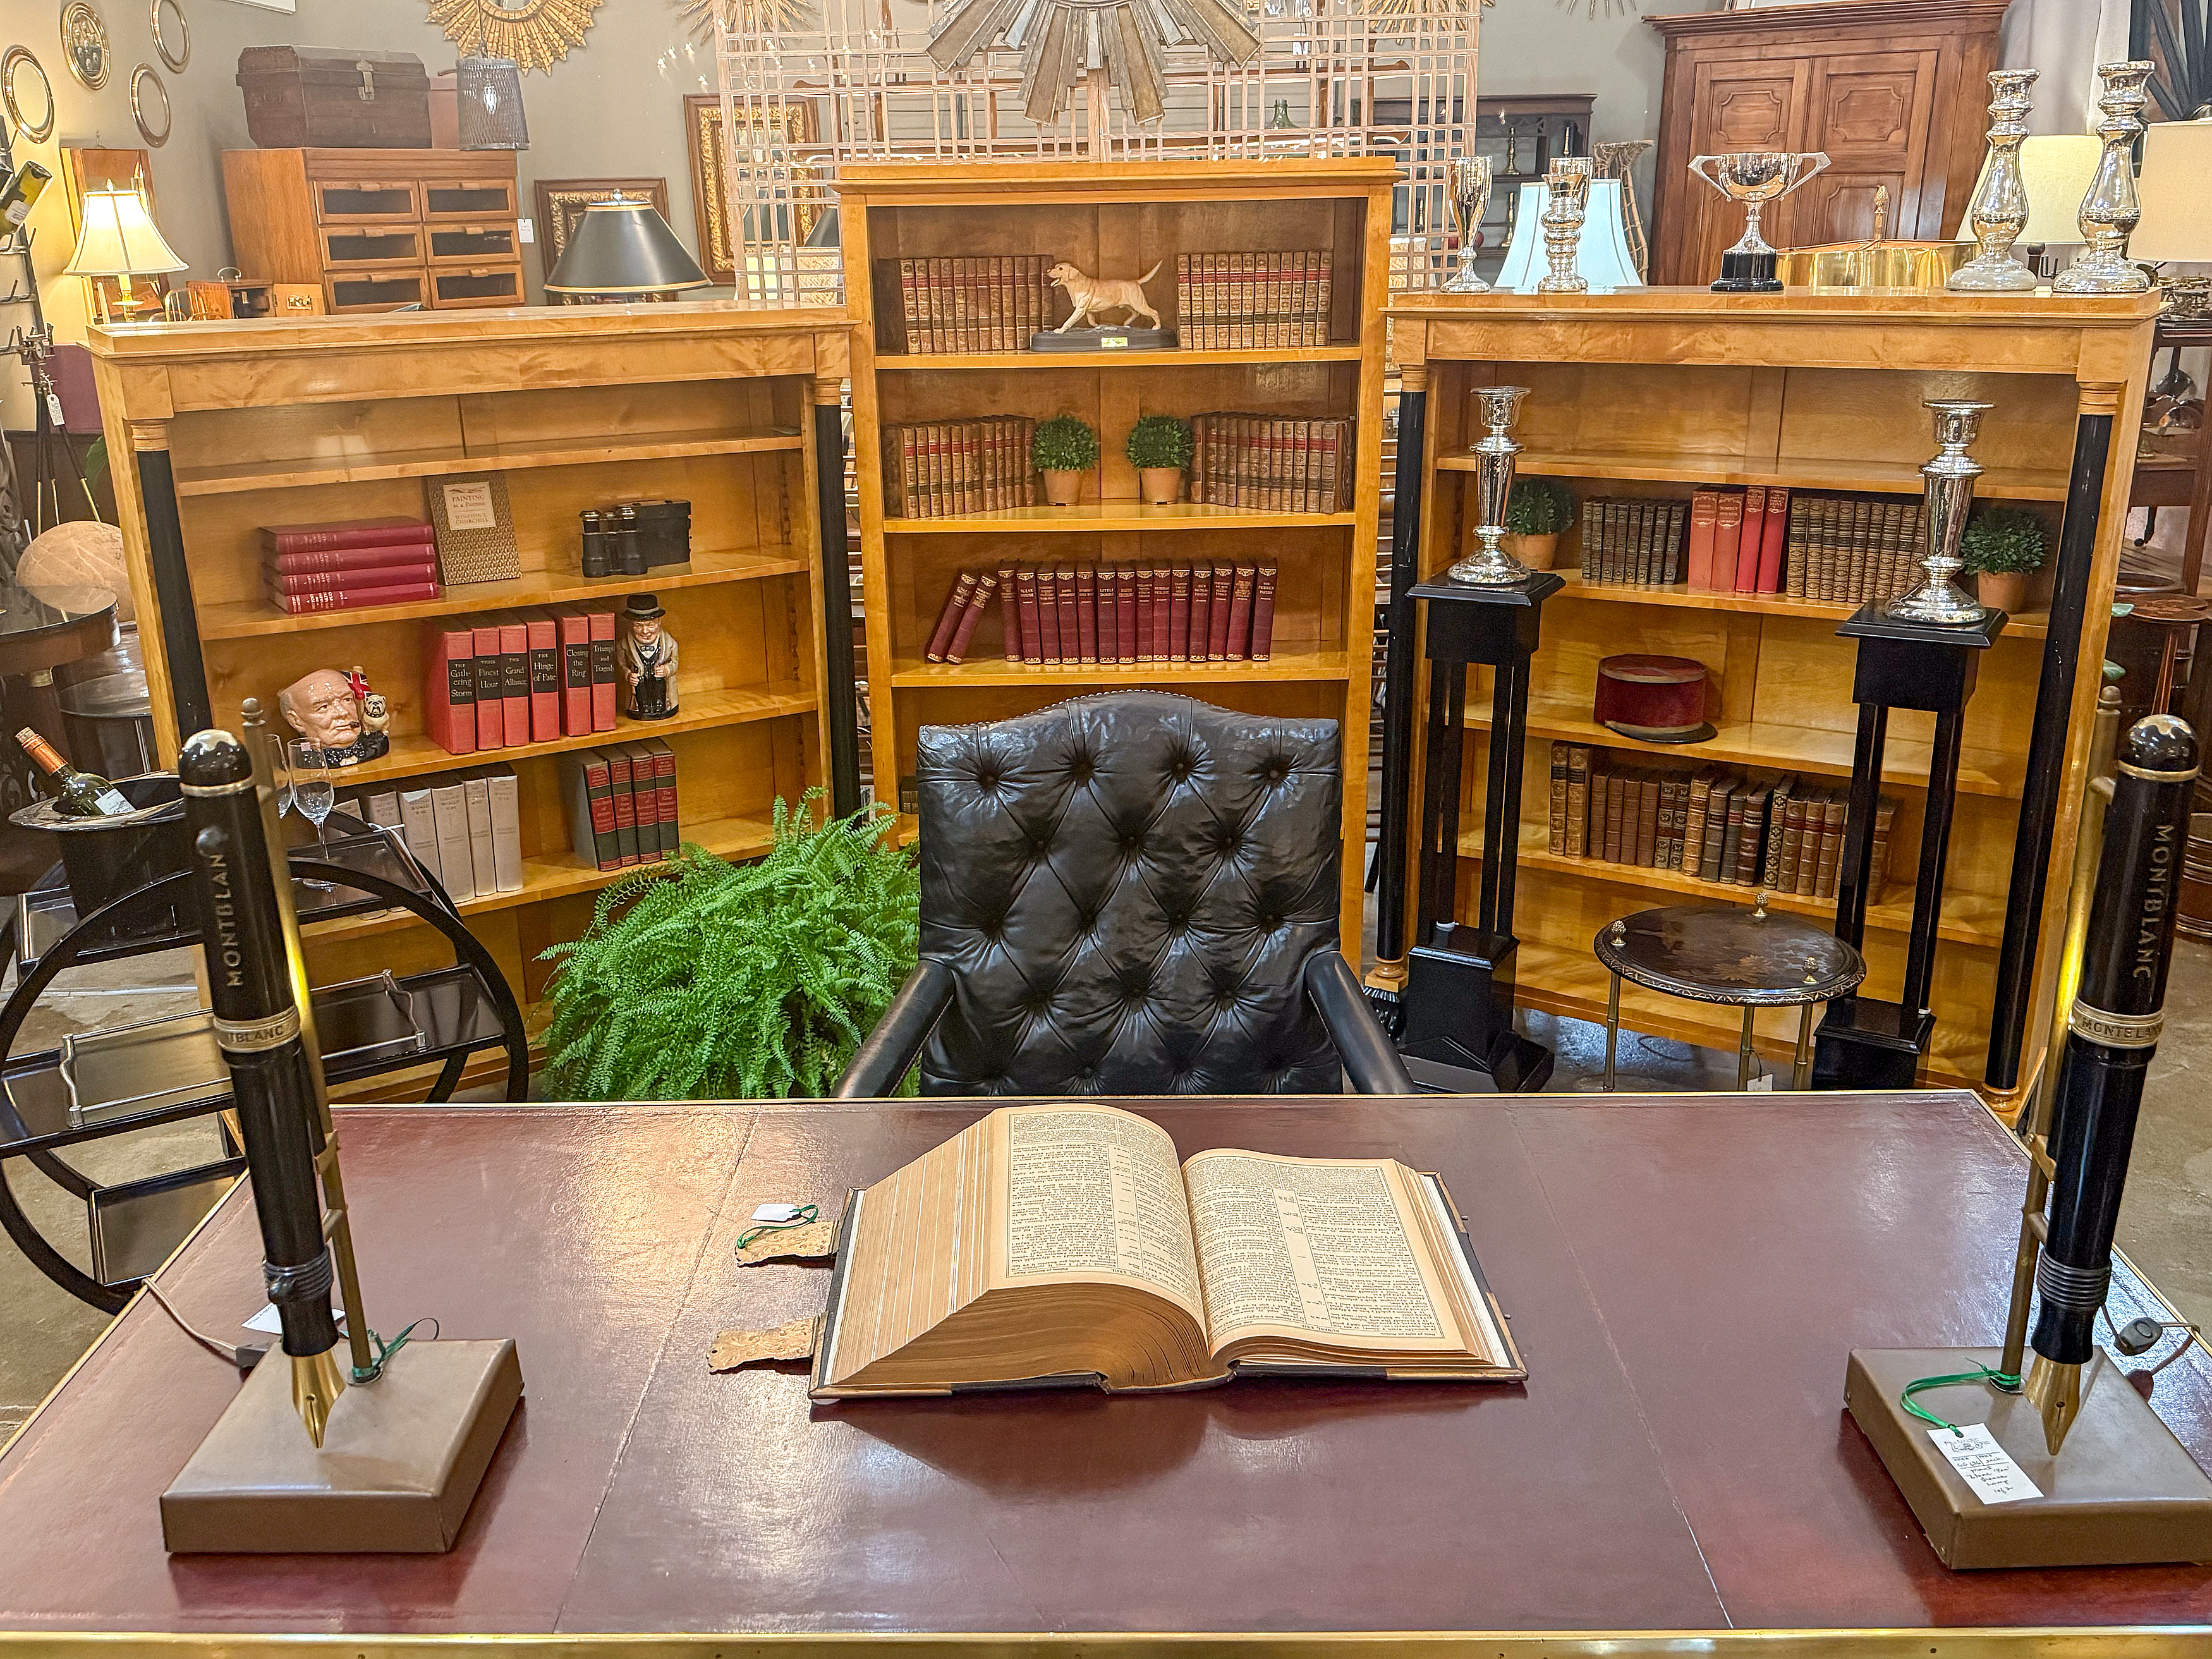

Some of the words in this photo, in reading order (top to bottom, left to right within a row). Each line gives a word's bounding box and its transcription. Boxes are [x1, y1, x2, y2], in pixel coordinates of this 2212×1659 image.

[506, 666, 525, 674] Grand
[534, 662, 554, 671] Hinge
[533, 673, 542, 681] of
[542, 673, 556, 681] Fate
[572, 669, 586, 678] Ring
[453, 678, 472, 688] ering
[451, 689, 473, 697] Storm
[209, 854, 245, 987] MONTBLAN
